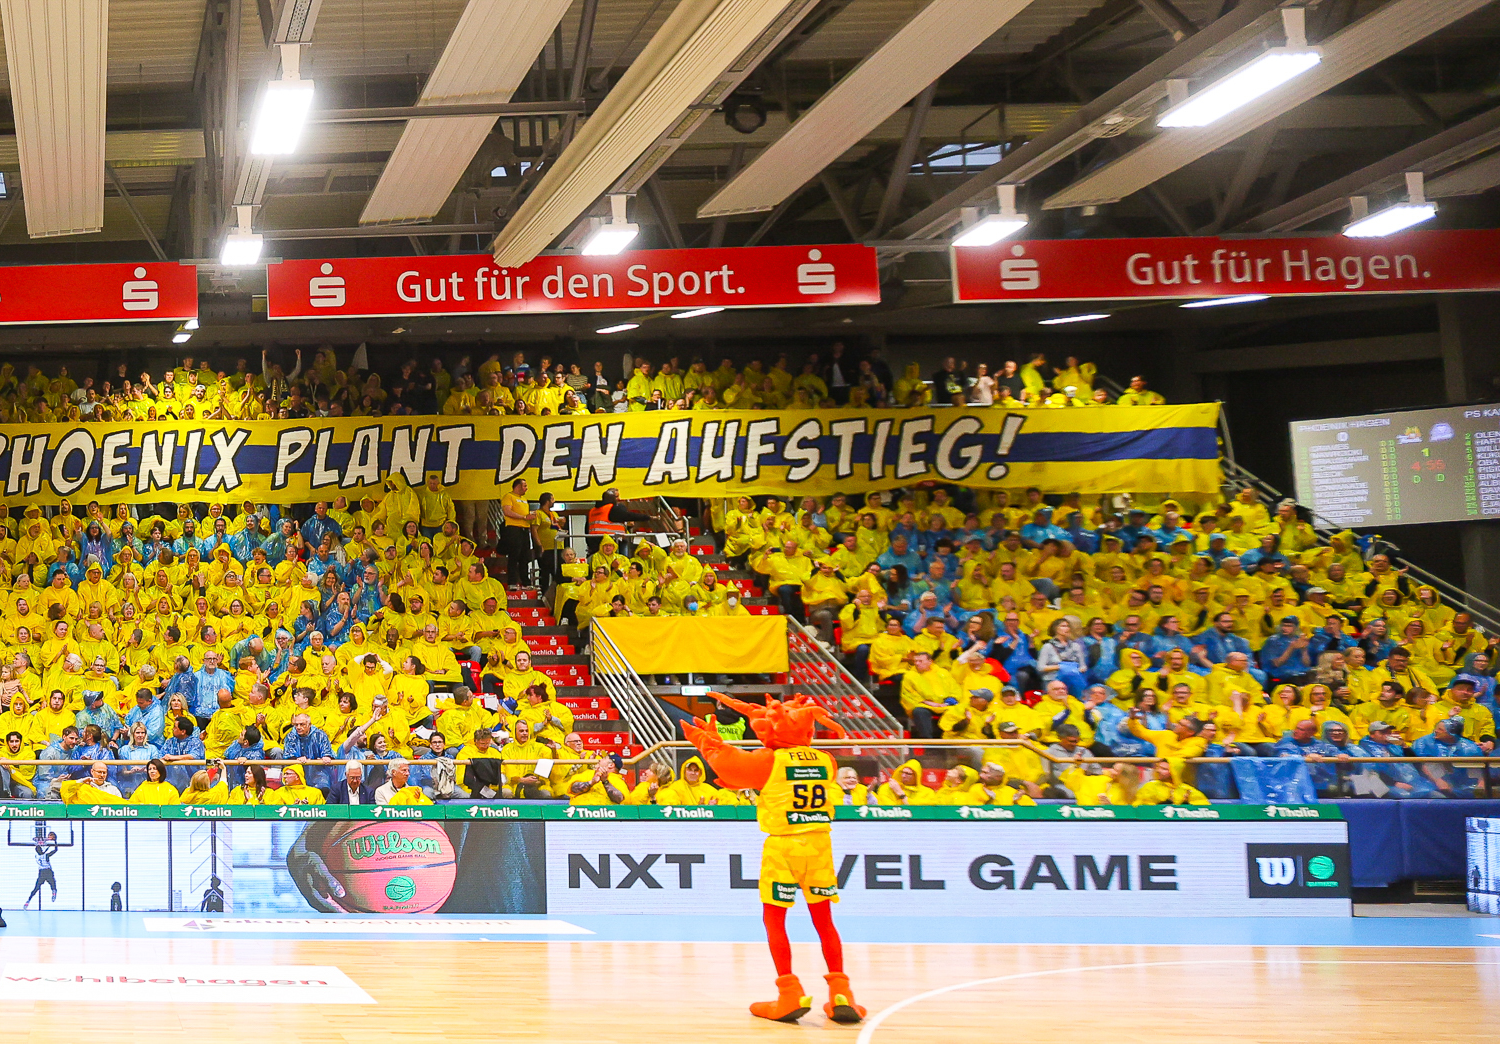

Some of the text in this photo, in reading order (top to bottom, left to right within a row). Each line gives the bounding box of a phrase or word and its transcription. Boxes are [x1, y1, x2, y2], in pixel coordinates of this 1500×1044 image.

[1126, 248, 1432, 290] Gut für Hagen.
[396, 263, 746, 304] Gut für den Sport.
[271, 422, 475, 490] PLANT
[495, 420, 627, 491] DEN
[643, 415, 1028, 485] AUFSTIEG!
[789, 752, 818, 760] FELIX
[793, 784, 827, 809] 58
[9, 806, 47, 816] Thalia
[101, 806, 138, 816] Thalia
[194, 806, 231, 816] Thalia
[289, 807, 327, 817] Thalia
[384, 807, 422, 817] Thalia
[480, 806, 518, 817] Thalia
[577, 807, 616, 818] Thalia
[680, 807, 714, 818] Thalia
[870, 806, 911, 817] Thalia
[972, 807, 1014, 818] Thalia
[1071, 807, 1116, 817] Thalia
[1173, 807, 1218, 818] Thalia
[1279, 807, 1319, 817] Thalia
[799, 813, 830, 822] Thalia
[346, 831, 442, 860] Wilson
[568, 853, 1179, 891] NXT LVEL GAME
[4, 976, 329, 986] wohlbehagen
